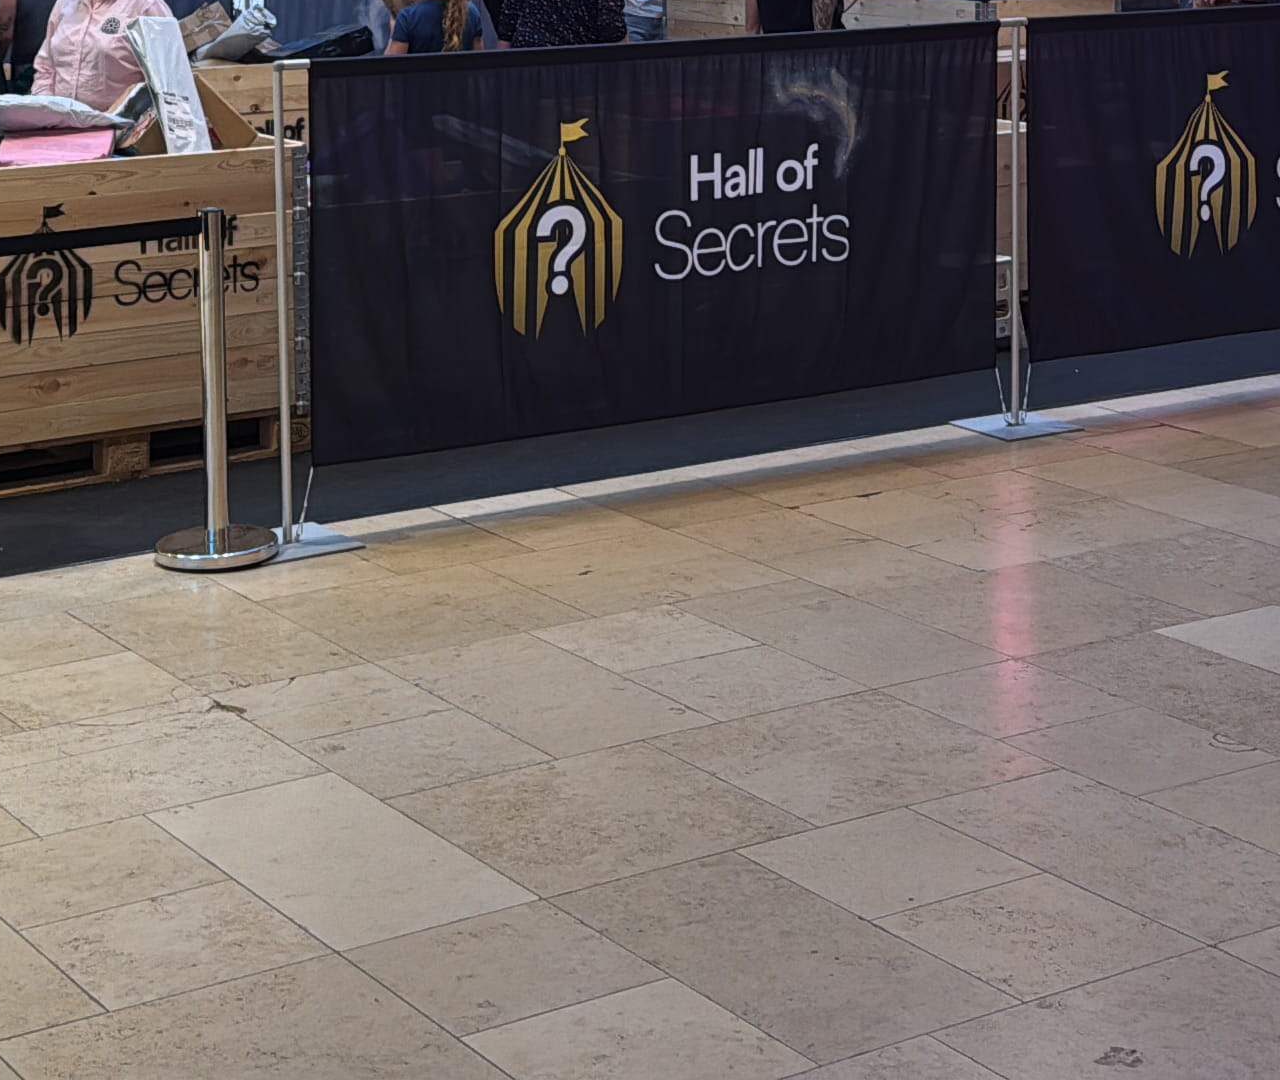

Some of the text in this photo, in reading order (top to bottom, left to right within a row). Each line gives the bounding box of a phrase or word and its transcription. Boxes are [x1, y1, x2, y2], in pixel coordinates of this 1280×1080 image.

[689, 143, 820, 202] Hall of
[654, 203, 851, 281] Secrets
